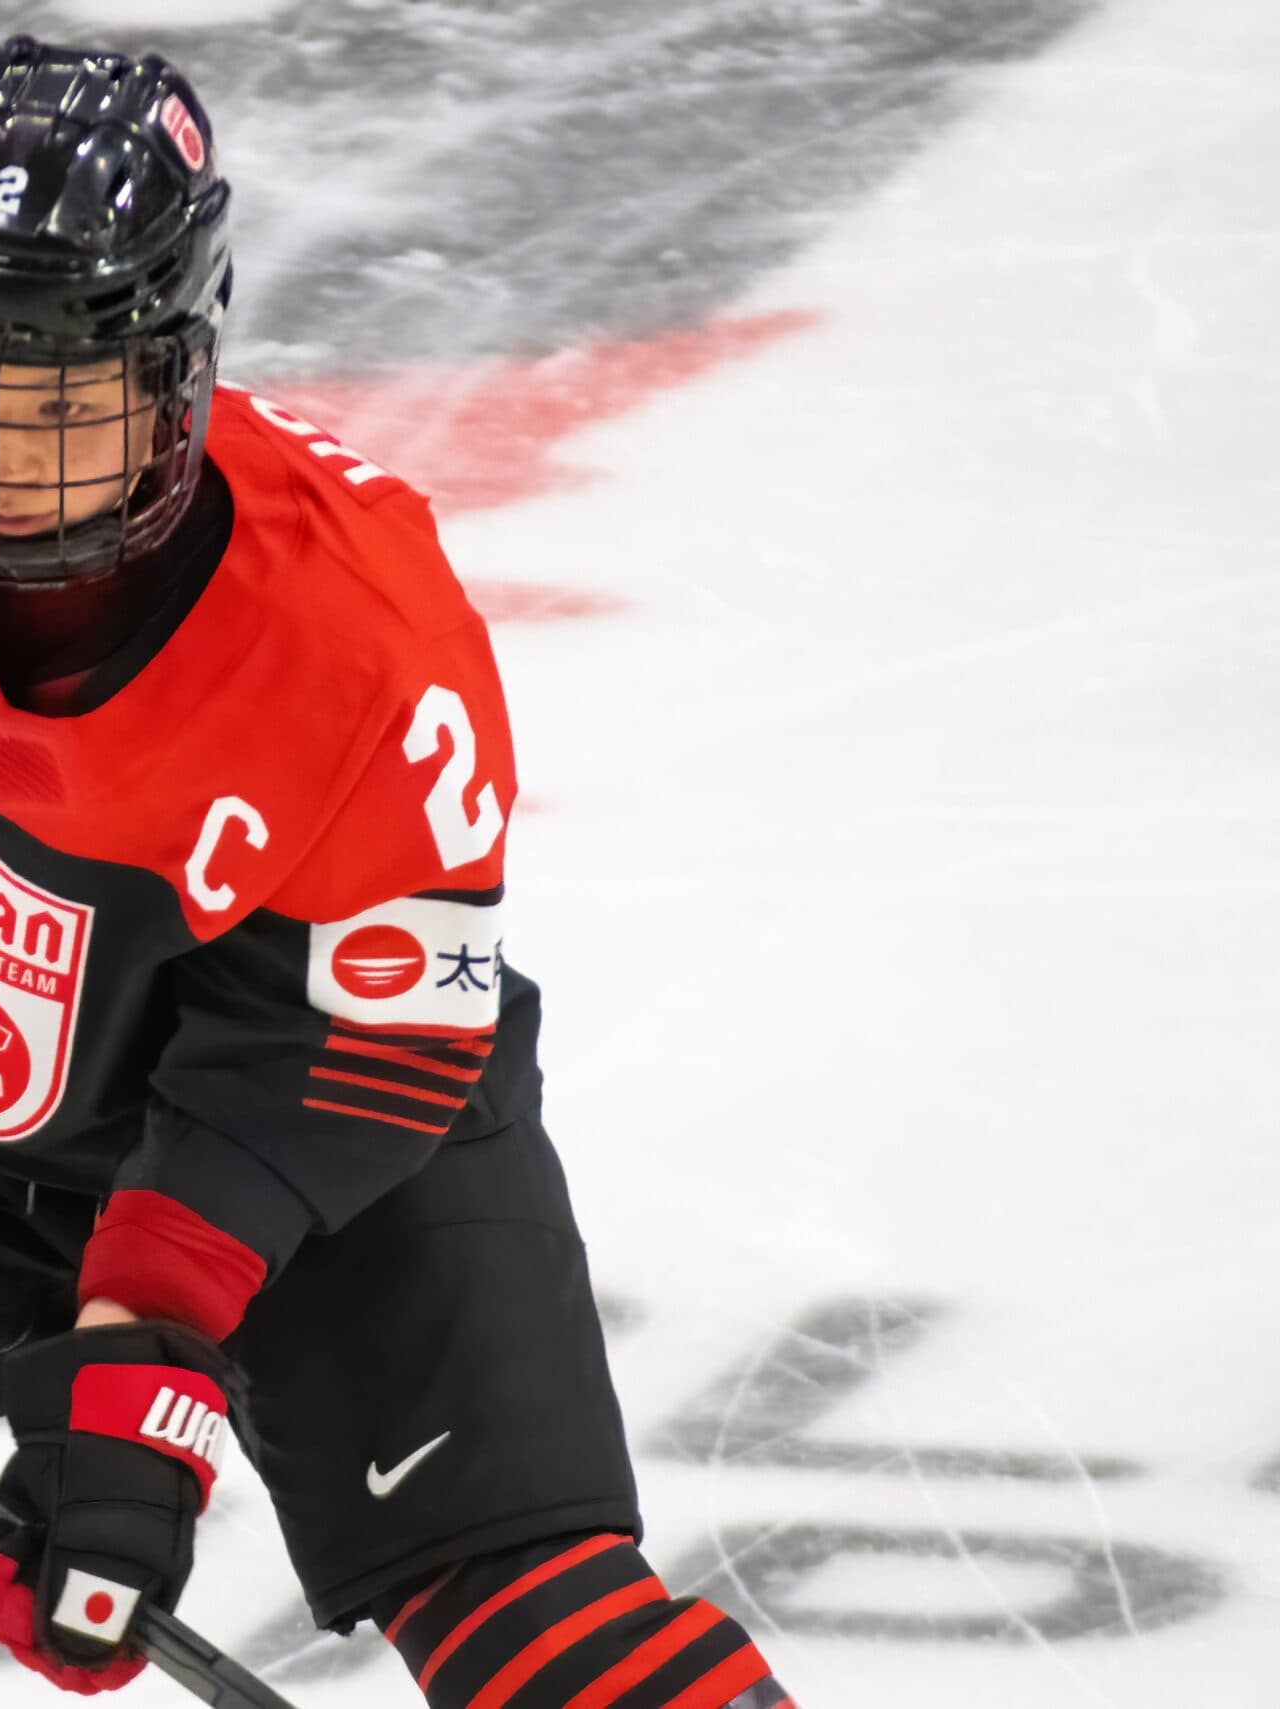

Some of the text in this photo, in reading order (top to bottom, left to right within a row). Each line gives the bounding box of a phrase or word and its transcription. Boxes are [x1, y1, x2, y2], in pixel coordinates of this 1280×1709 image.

[402, 684, 504, 871] 2
[184, 795, 269, 912] C
[435, 936, 503, 992] 太
